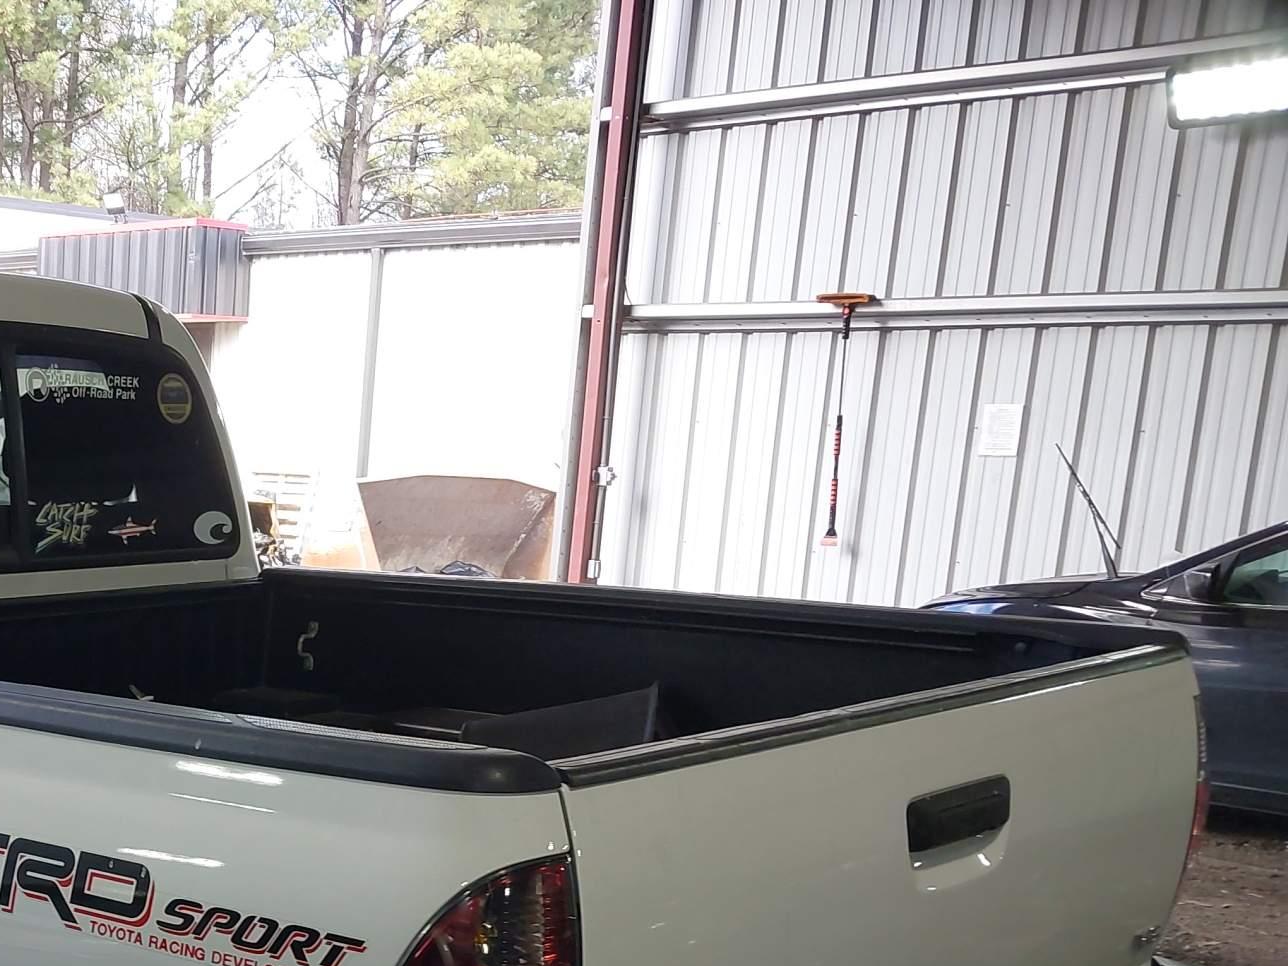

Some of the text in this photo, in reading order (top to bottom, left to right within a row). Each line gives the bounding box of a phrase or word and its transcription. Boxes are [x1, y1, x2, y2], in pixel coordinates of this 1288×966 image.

[72, 386, 136, 401] Off-Road Park
[107, 375, 140, 388] CREEK
[36, 501, 98, 525] CATCH
[36, 521, 91, 553] SURF
[89, 918, 144, 946] TOYOTA
[148, 933, 206, 961] RACING
